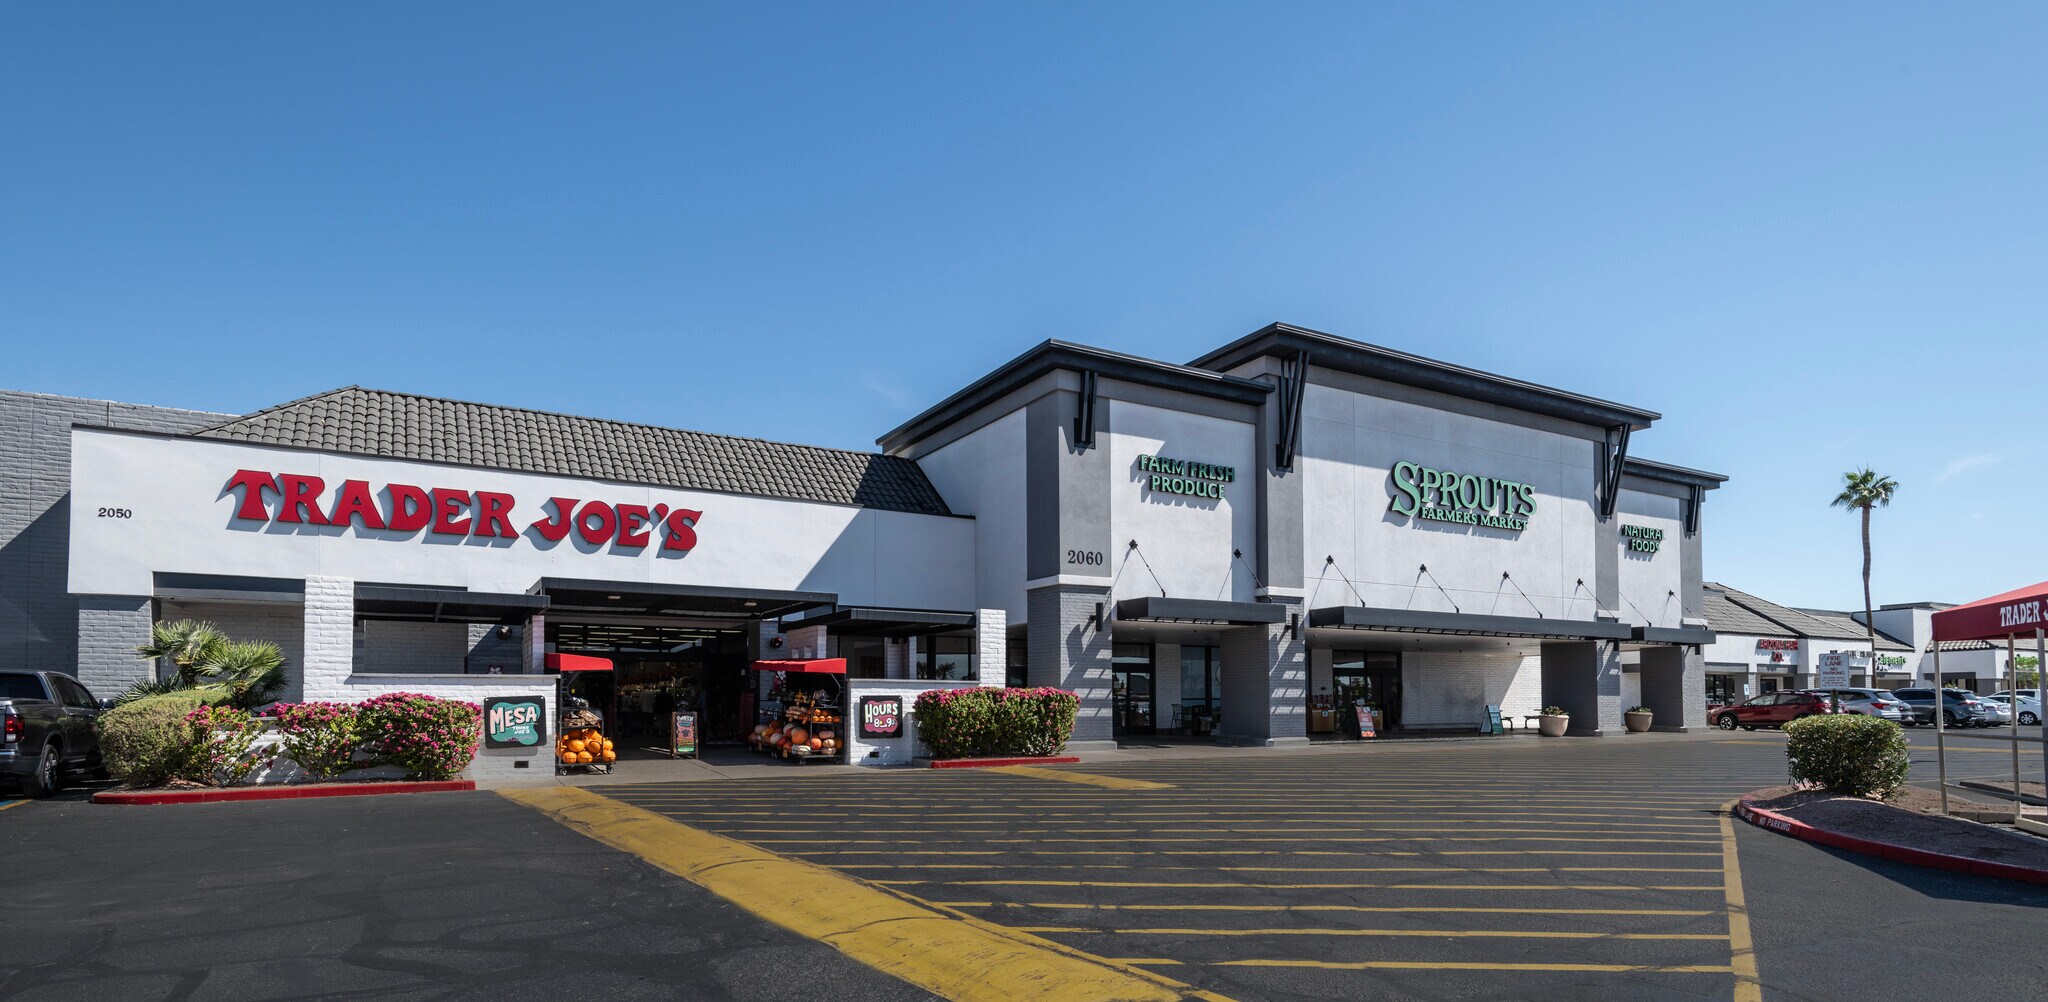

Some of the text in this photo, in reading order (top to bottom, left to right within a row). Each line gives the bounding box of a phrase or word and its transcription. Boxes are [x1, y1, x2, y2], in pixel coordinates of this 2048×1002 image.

[1139, 454, 1236, 482] FARM FRESH
[1149, 475, 1226, 499] PRODUCE
[98, 507, 132, 519] 2050
[225, 469, 704, 552] TRADER JOE'S
[1420, 506, 1528, 532] FARMERS MARKET
[1628, 538, 1661, 553] FOODS
[1067, 550, 1104, 566] 2060
[2000, 601, 2042, 628] TRADER
[1767, 818, 1791, 832] PARKING
